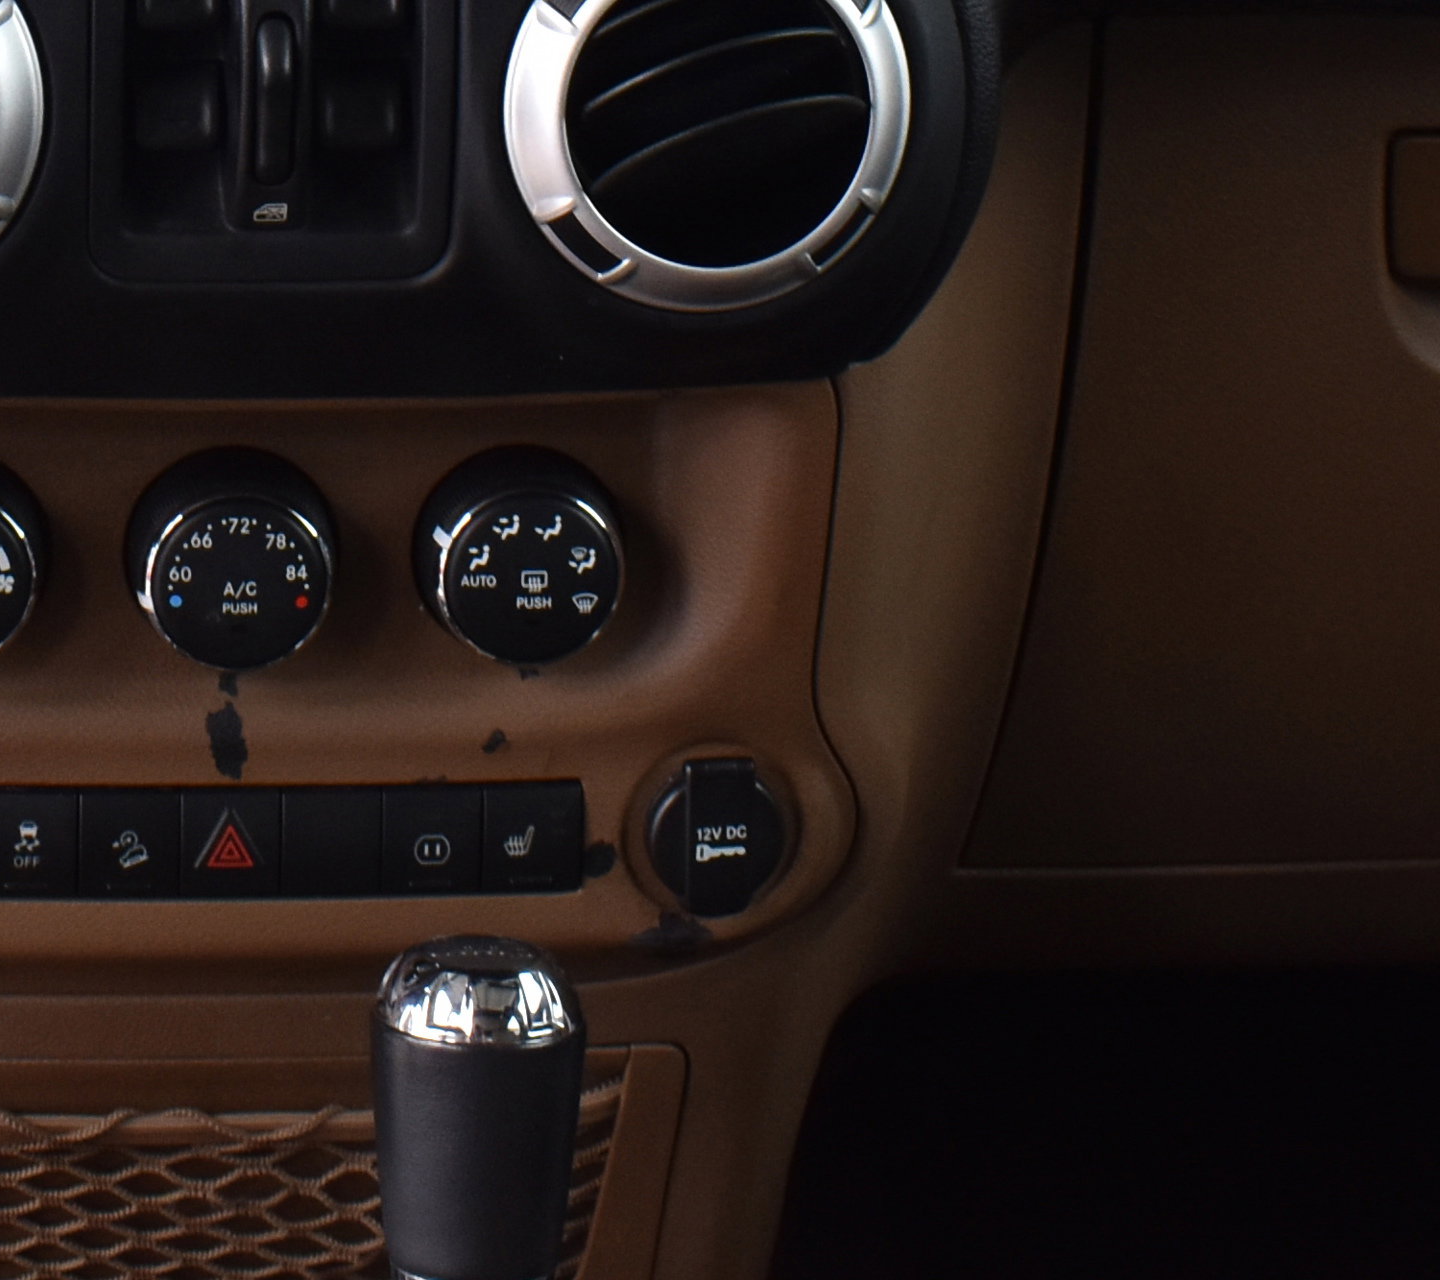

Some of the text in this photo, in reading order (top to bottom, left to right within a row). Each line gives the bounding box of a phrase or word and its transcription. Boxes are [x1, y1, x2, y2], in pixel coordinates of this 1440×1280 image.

[227, 518, 251, 535] 72
[190, 533, 213, 549] 66
[264, 534, 287, 550] 78
[168, 565, 192, 583] 60
[285, 564, 308, 581] 84
[223, 581, 258, 598] A/C
[461, 575, 497, 588] AUTO
[222, 602, 258, 615] PUSH
[516, 597, 553, 610] PUSH
[696, 825, 747, 842] 12V DC
[13, 855, 40, 869] OFF
